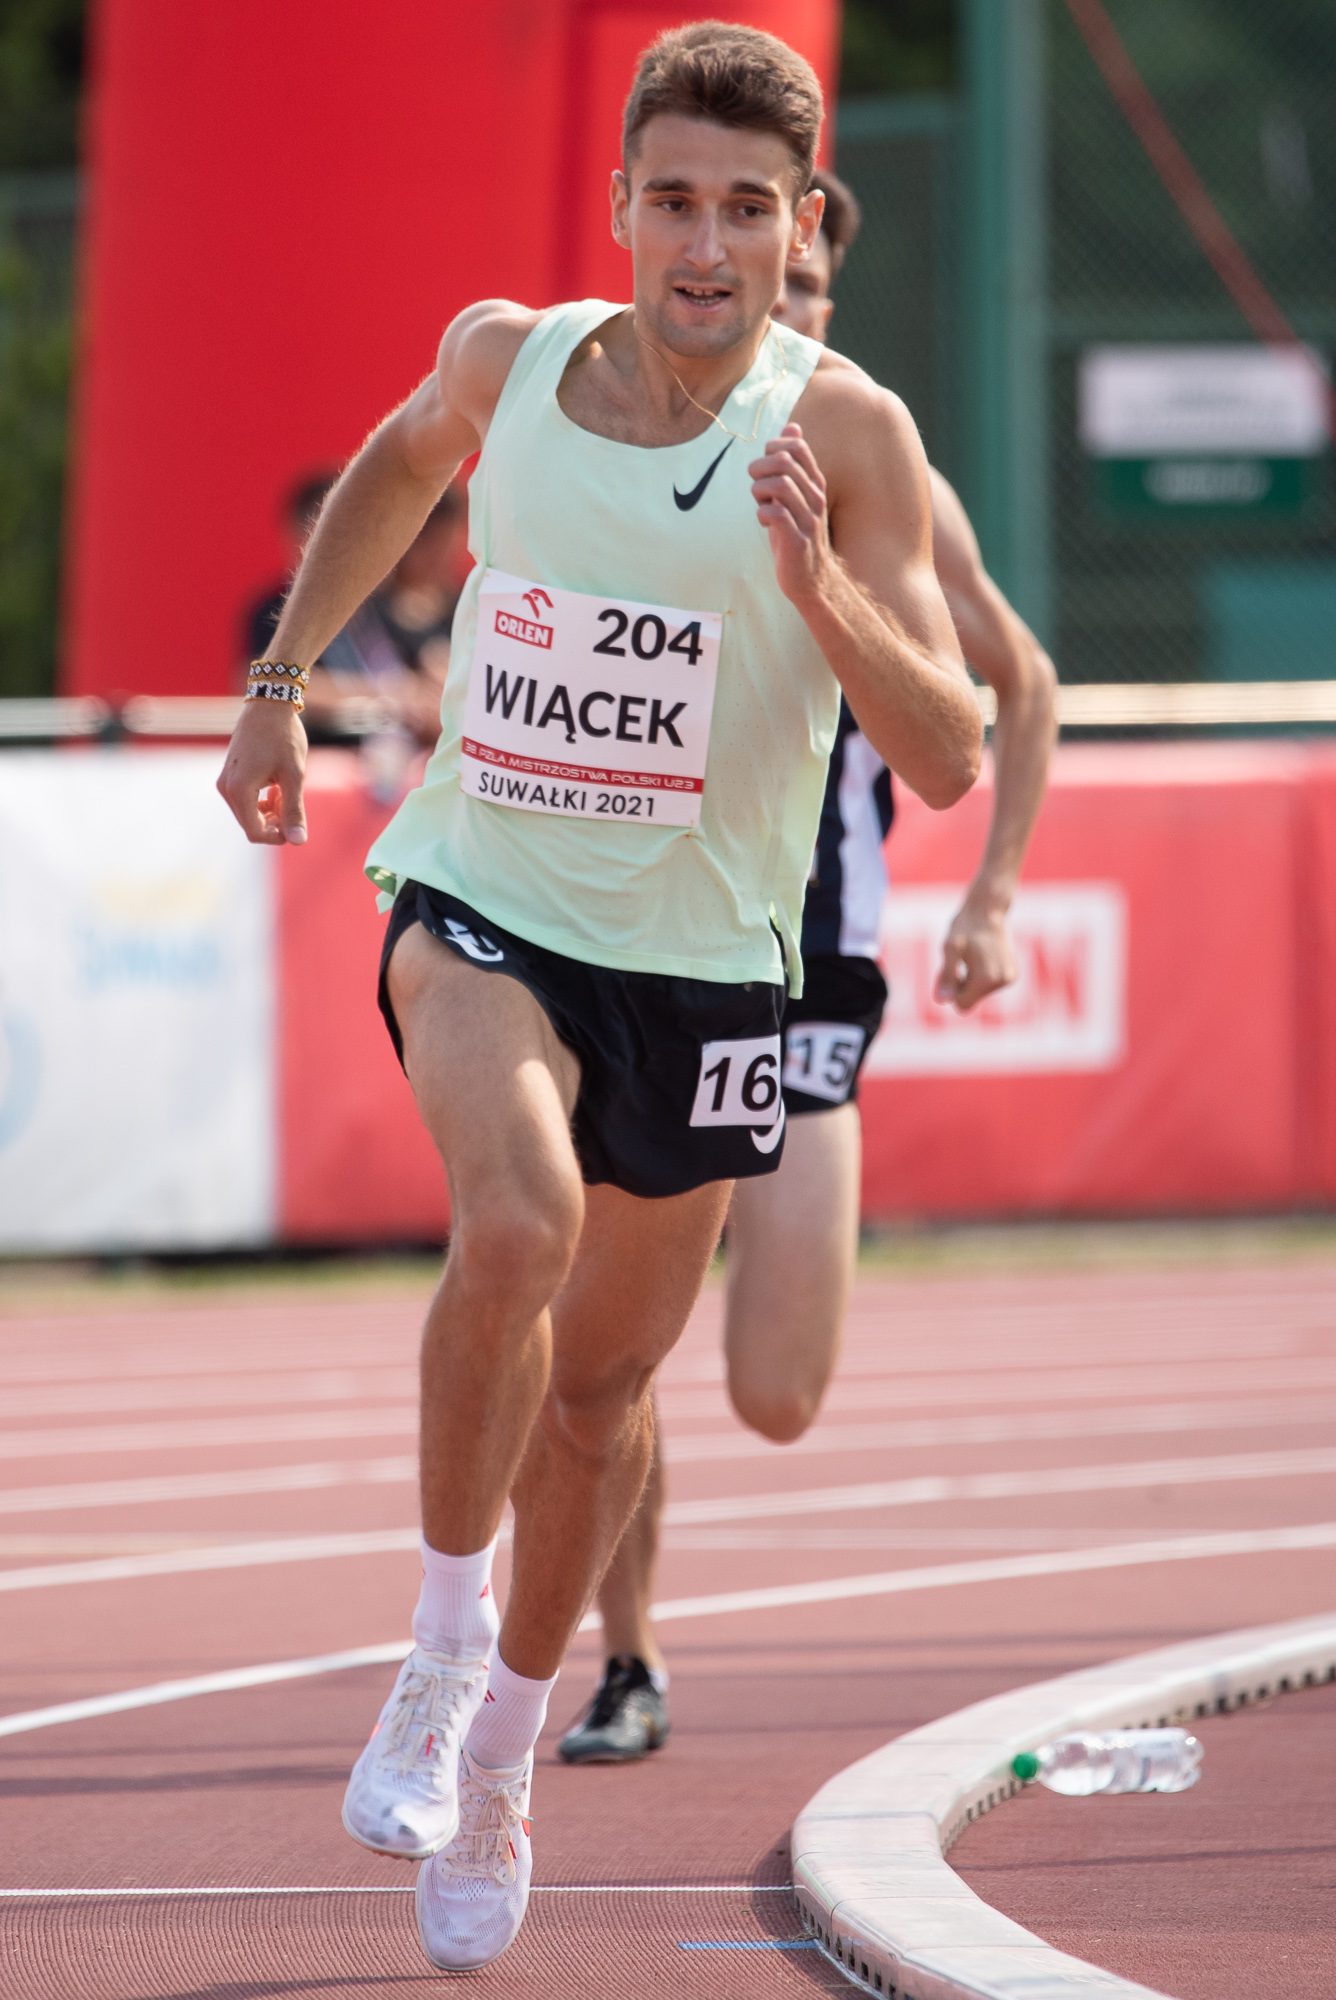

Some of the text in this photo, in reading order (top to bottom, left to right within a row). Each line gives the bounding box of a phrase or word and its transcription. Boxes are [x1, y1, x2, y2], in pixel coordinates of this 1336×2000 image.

[497, 614, 550, 646] ORLEN
[592, 608, 704, 667] 204
[485, 663, 689, 749] WIĄCEK
[478, 771, 655, 817] SUWAŁKI 2021
[479, 748, 507, 766] PZLA
[508, 757, 609, 783] MISTRZOSTWA
[610, 773, 662, 787] POLSKI
[663, 778, 695, 790] U23
[704, 1053, 778, 1113] 16
[792, 1036, 853, 1087] 15
